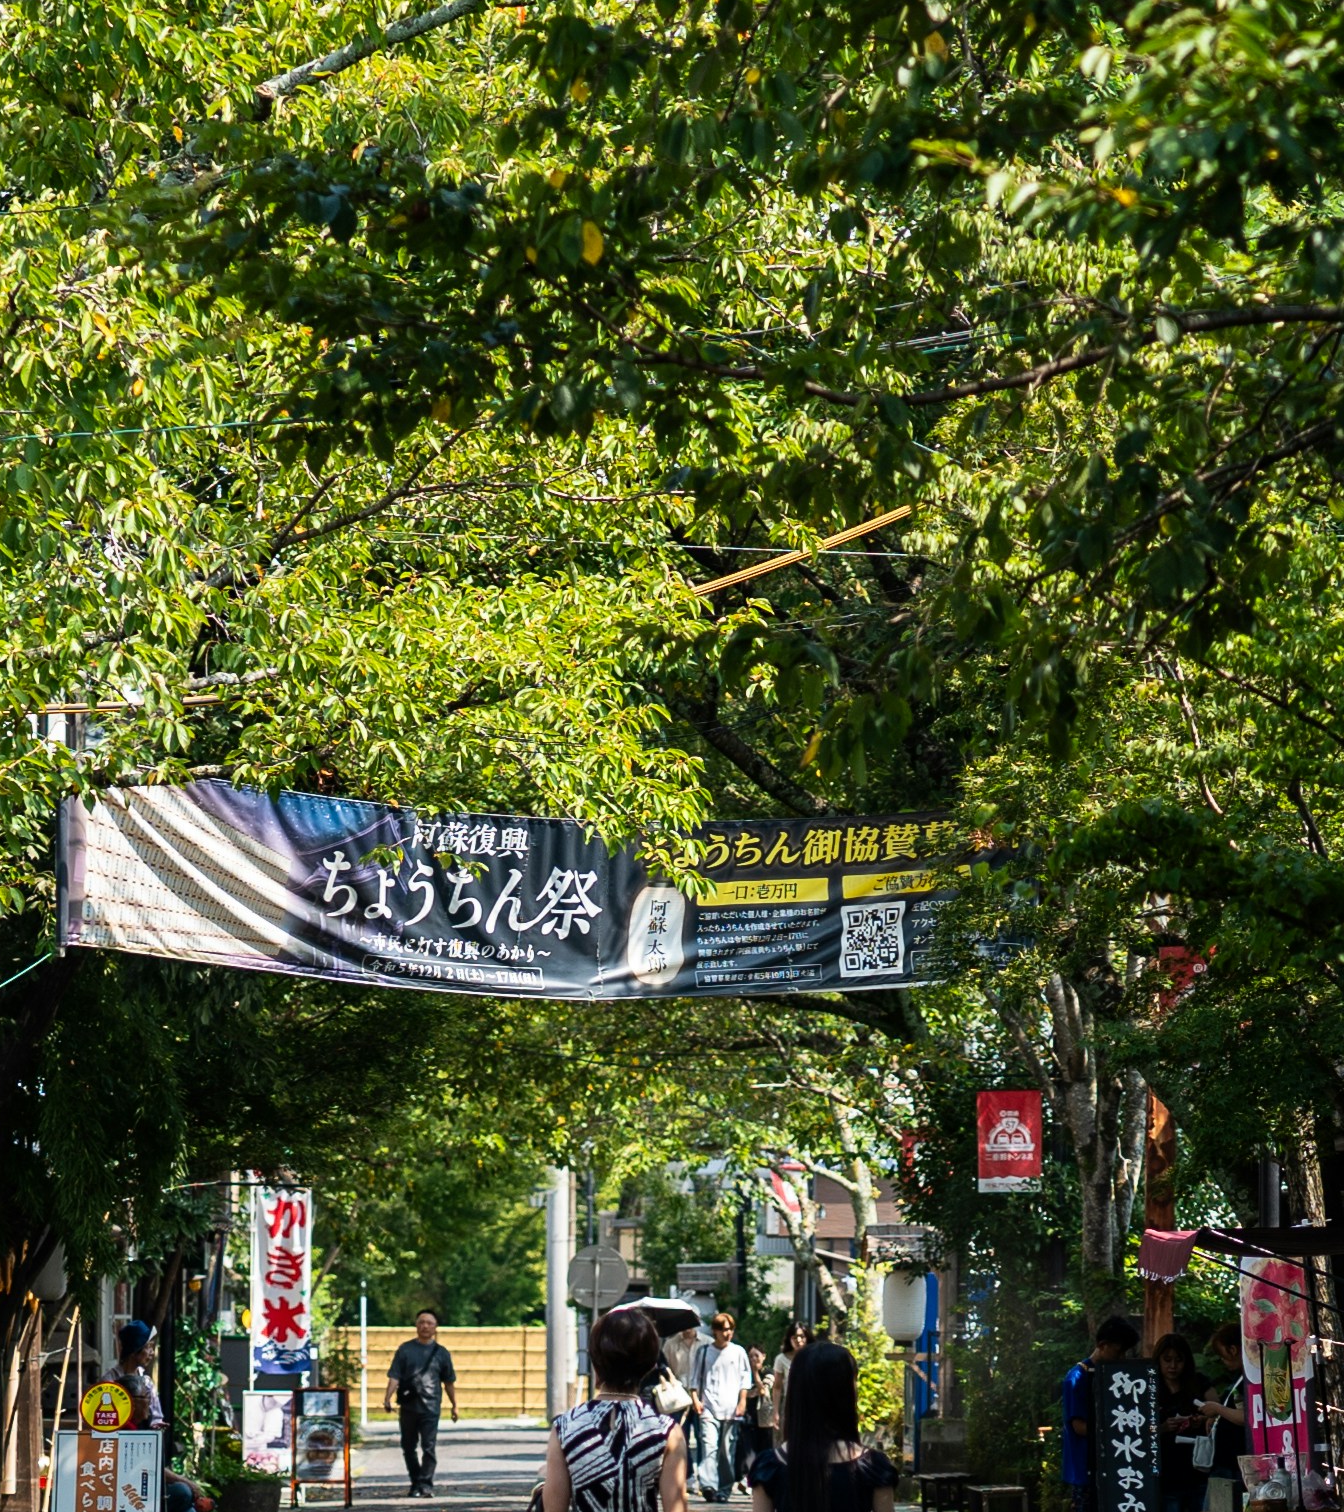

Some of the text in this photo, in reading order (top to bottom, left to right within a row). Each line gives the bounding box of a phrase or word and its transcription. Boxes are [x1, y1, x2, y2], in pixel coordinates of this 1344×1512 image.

[411, 818, 529, 859] 阿蘇復興
[322, 850, 603, 941] ちょうちん祭
[645, 899, 671, 974] 阿蘇太郎
[260, 1196, 307, 1343] かき氷
